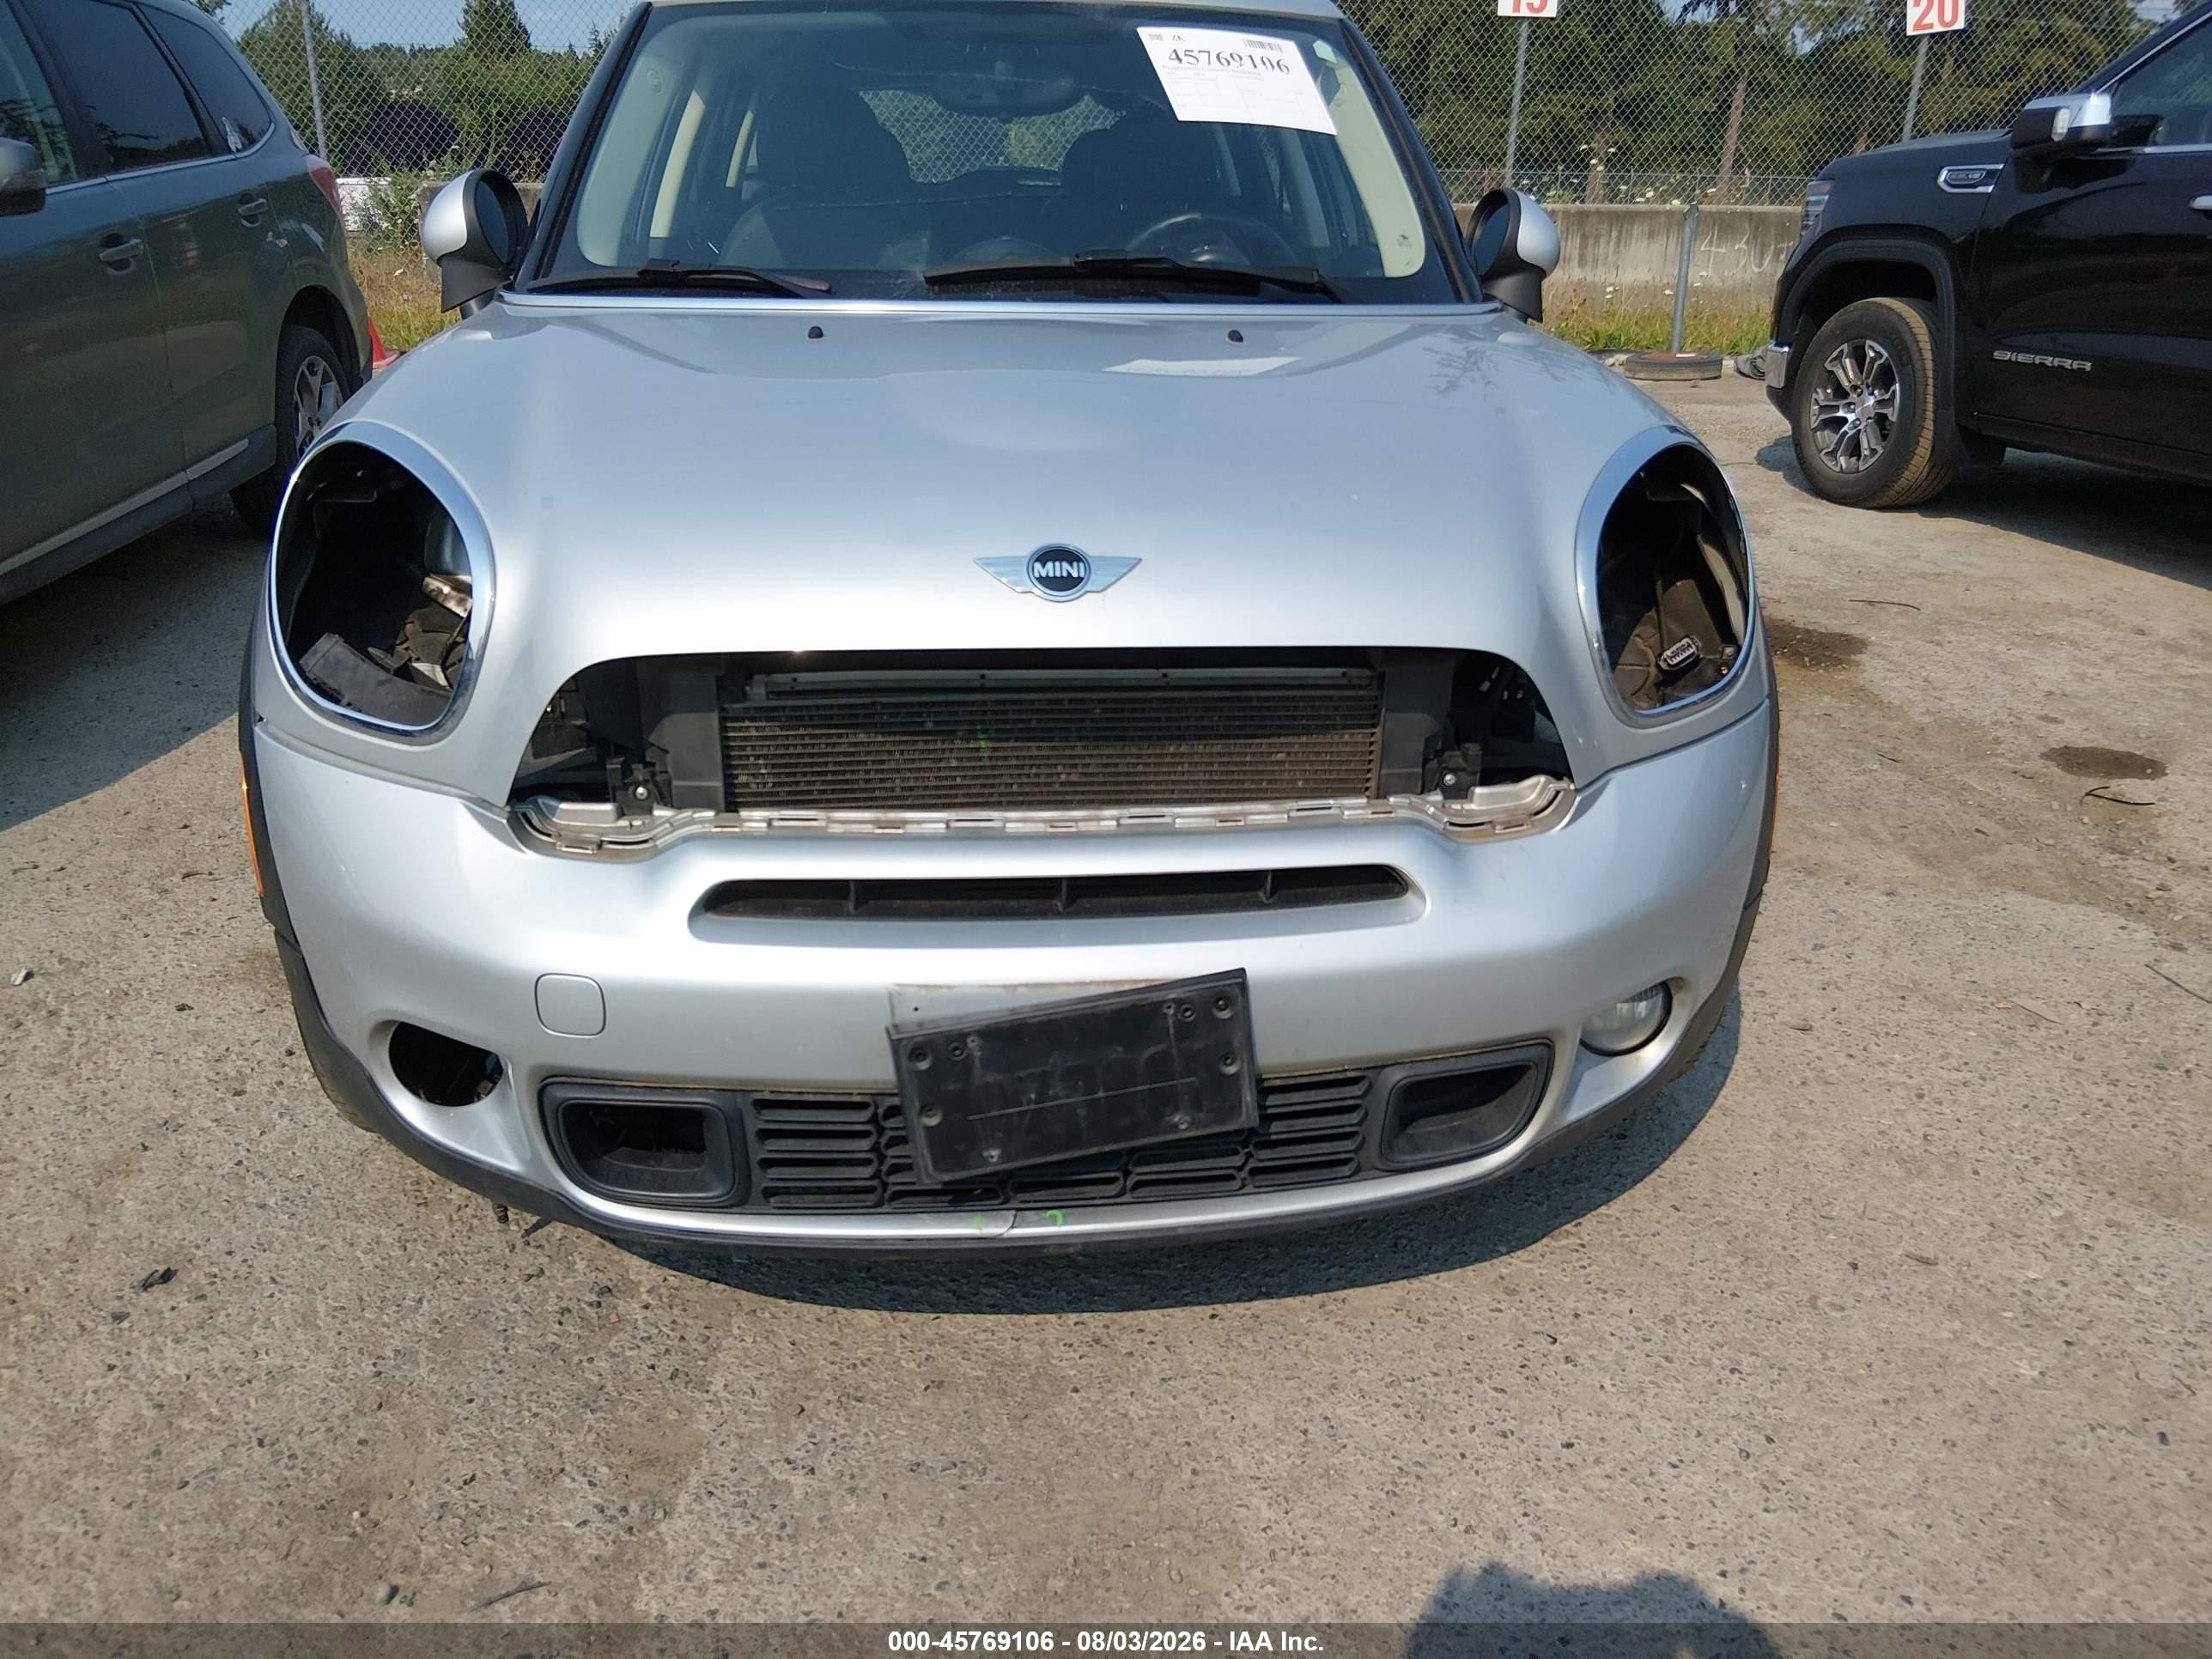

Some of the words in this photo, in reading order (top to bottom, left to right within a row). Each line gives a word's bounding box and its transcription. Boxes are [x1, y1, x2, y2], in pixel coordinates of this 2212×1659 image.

[1912, 0, 1960, 32] 20
[1168, 48, 1291, 76] 45769106
[1992, 349, 2093, 372] SIERRA
[1033, 560, 1085, 579] MINI
